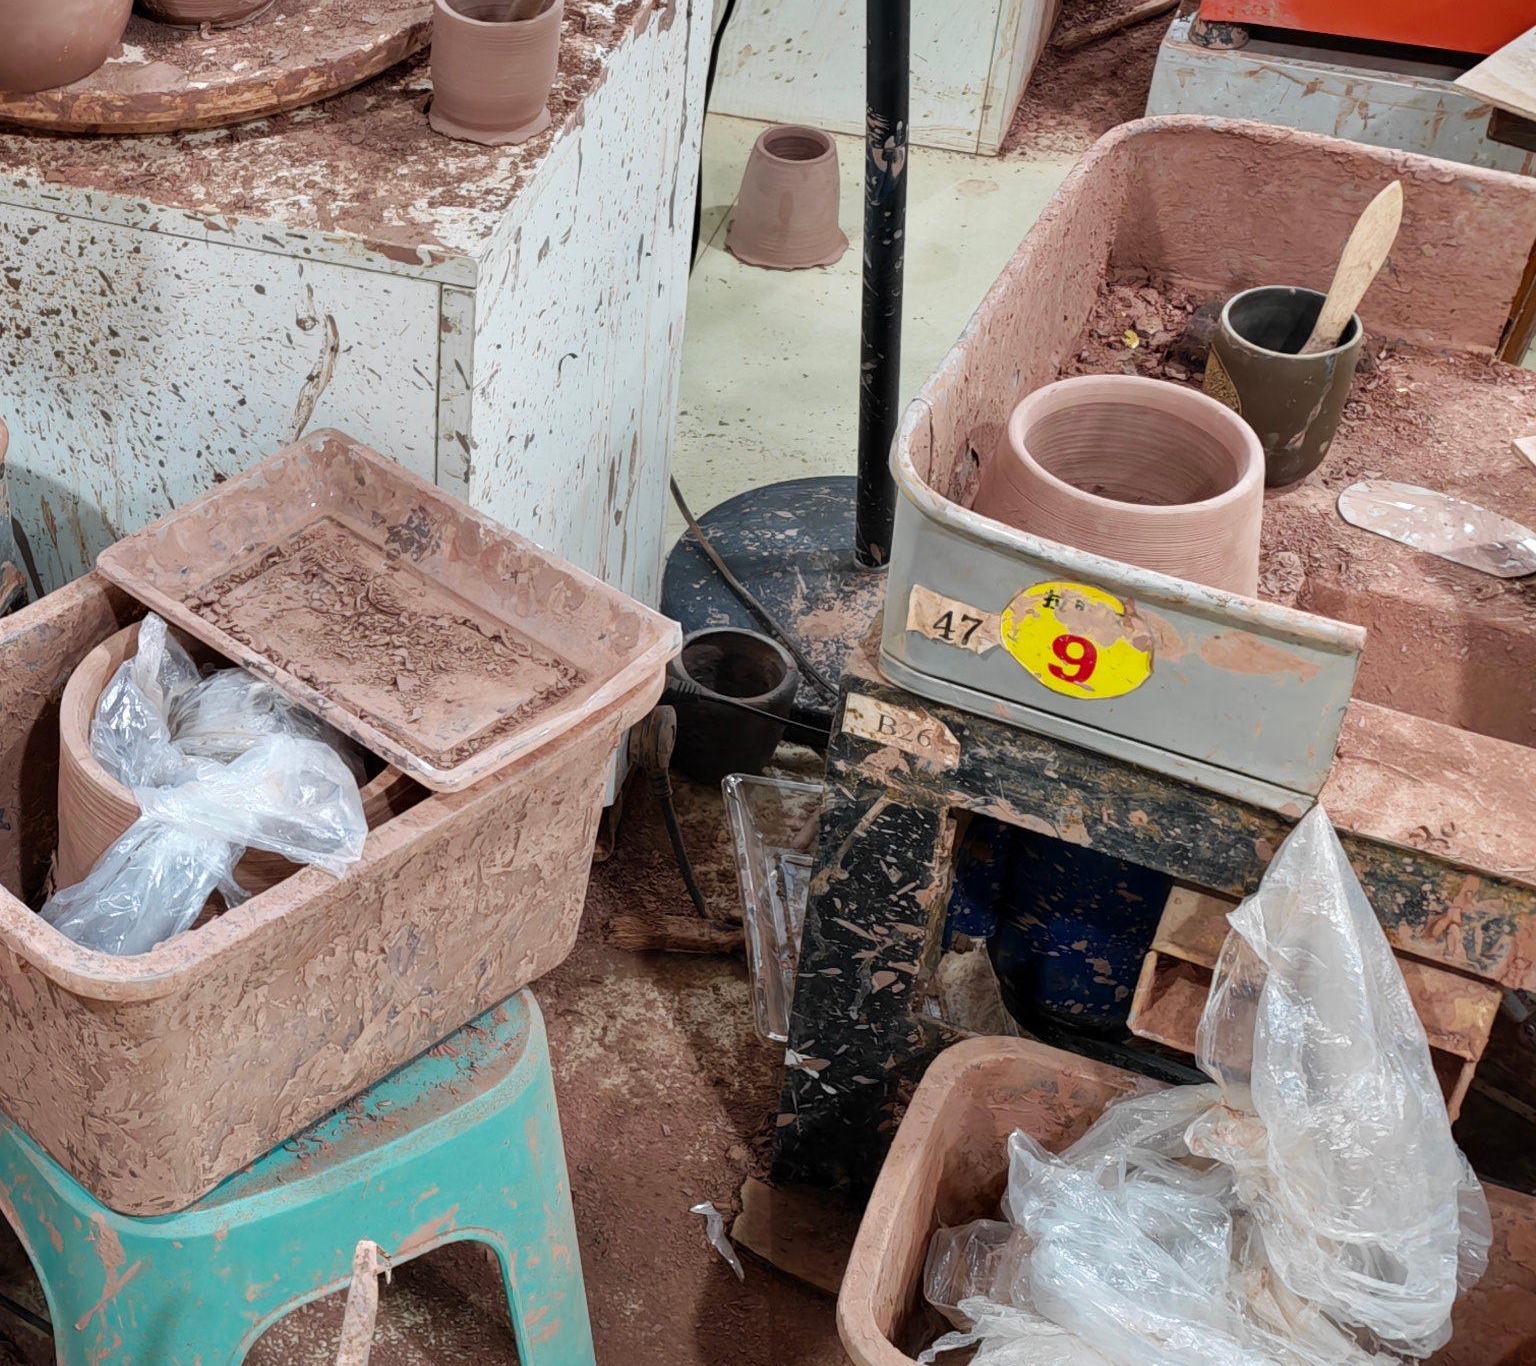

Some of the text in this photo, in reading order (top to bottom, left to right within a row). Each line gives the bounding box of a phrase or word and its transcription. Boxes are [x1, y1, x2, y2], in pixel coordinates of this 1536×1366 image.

[932, 609, 984, 646] 47
[1048, 634, 1098, 684] 9
[877, 714, 935, 749] B26
